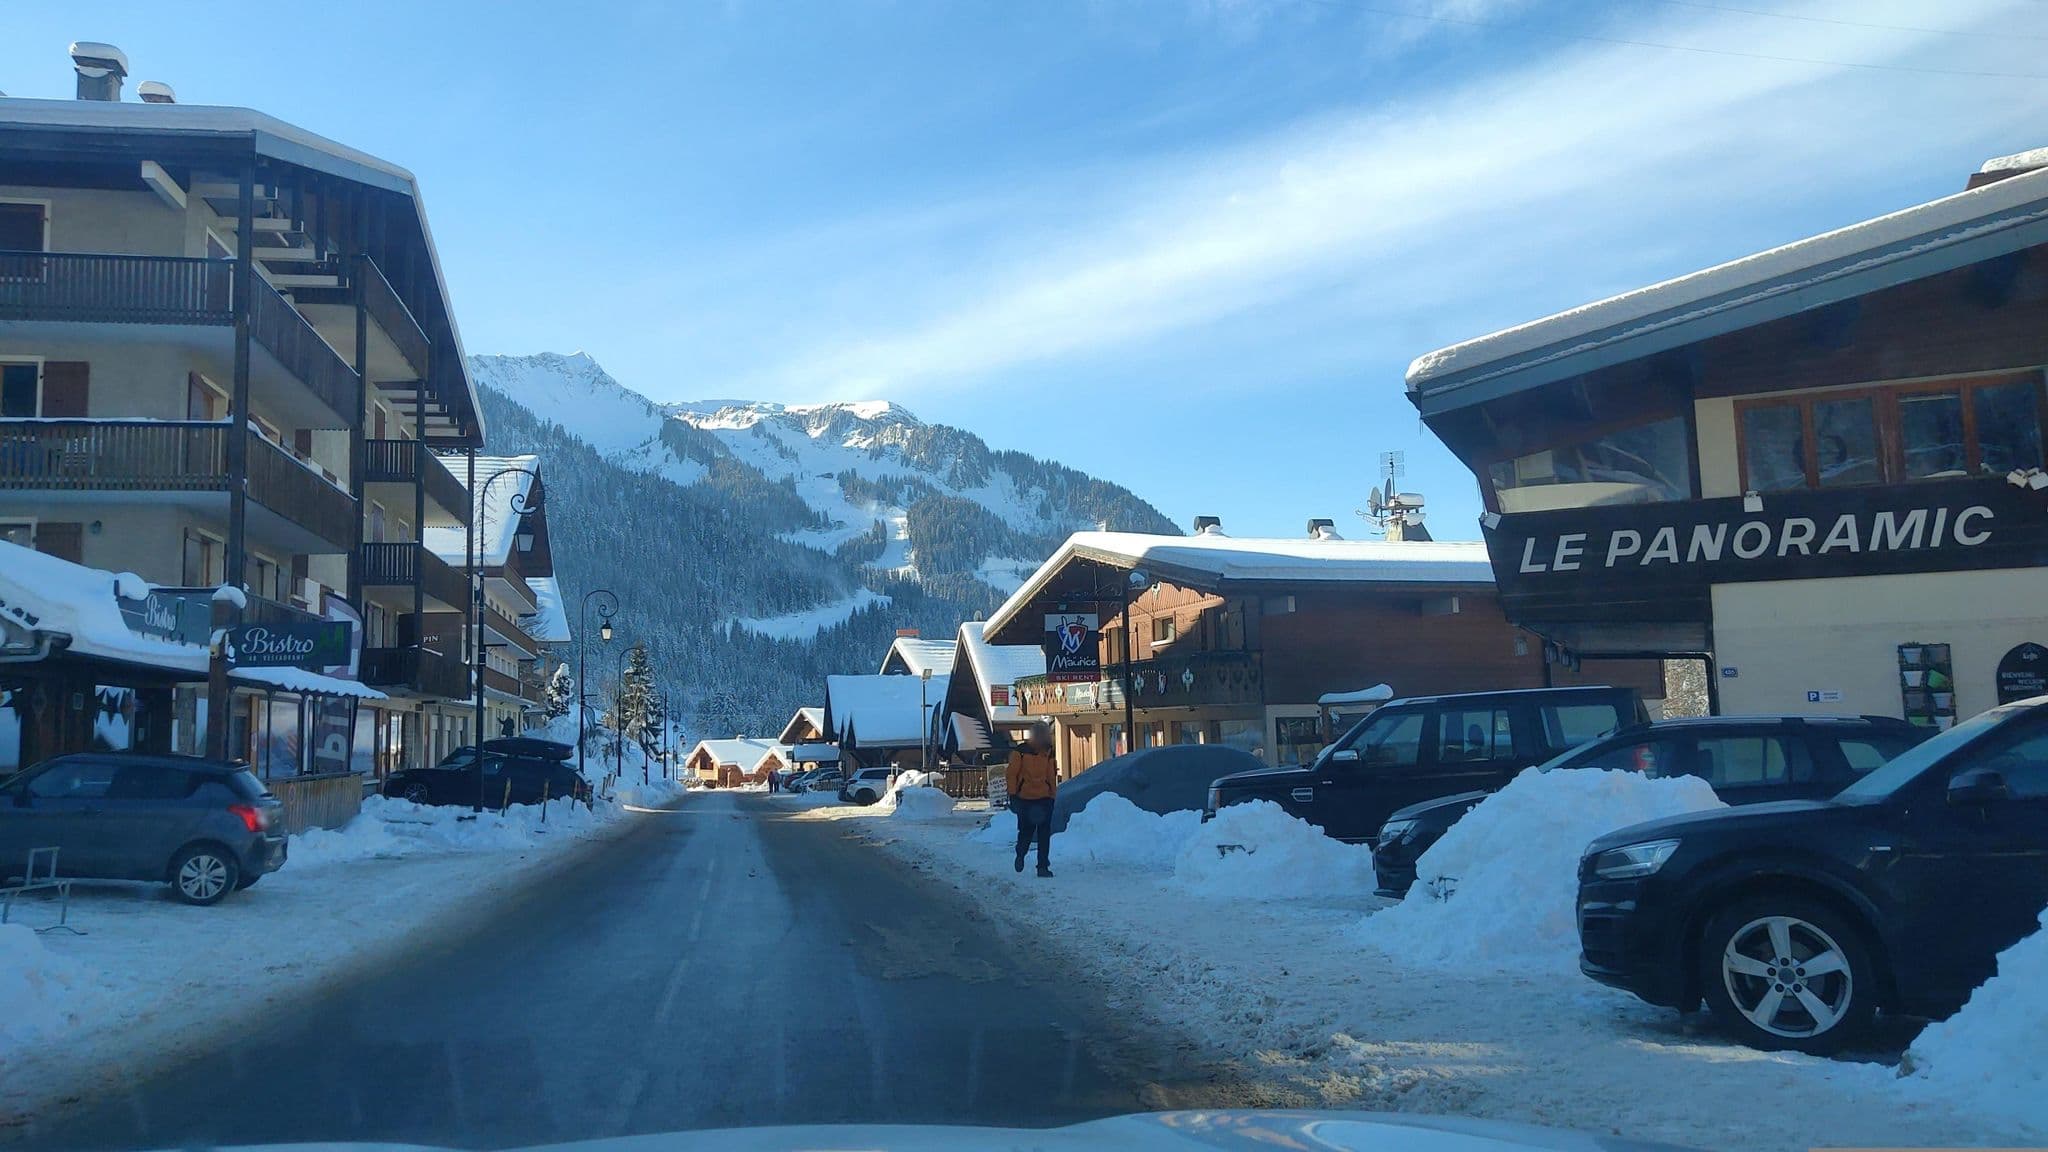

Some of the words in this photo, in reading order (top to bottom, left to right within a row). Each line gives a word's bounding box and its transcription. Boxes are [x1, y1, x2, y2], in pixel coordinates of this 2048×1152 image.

[1519, 533, 1587, 573] LE
[1605, 505, 1994, 567] PANORAMIC
[144, 594, 176, 631] Bistro
[241, 627, 314, 654] Bistro
[1051, 654, 1097, 672] Maurice
[1072, 673, 1094, 681] RENT
